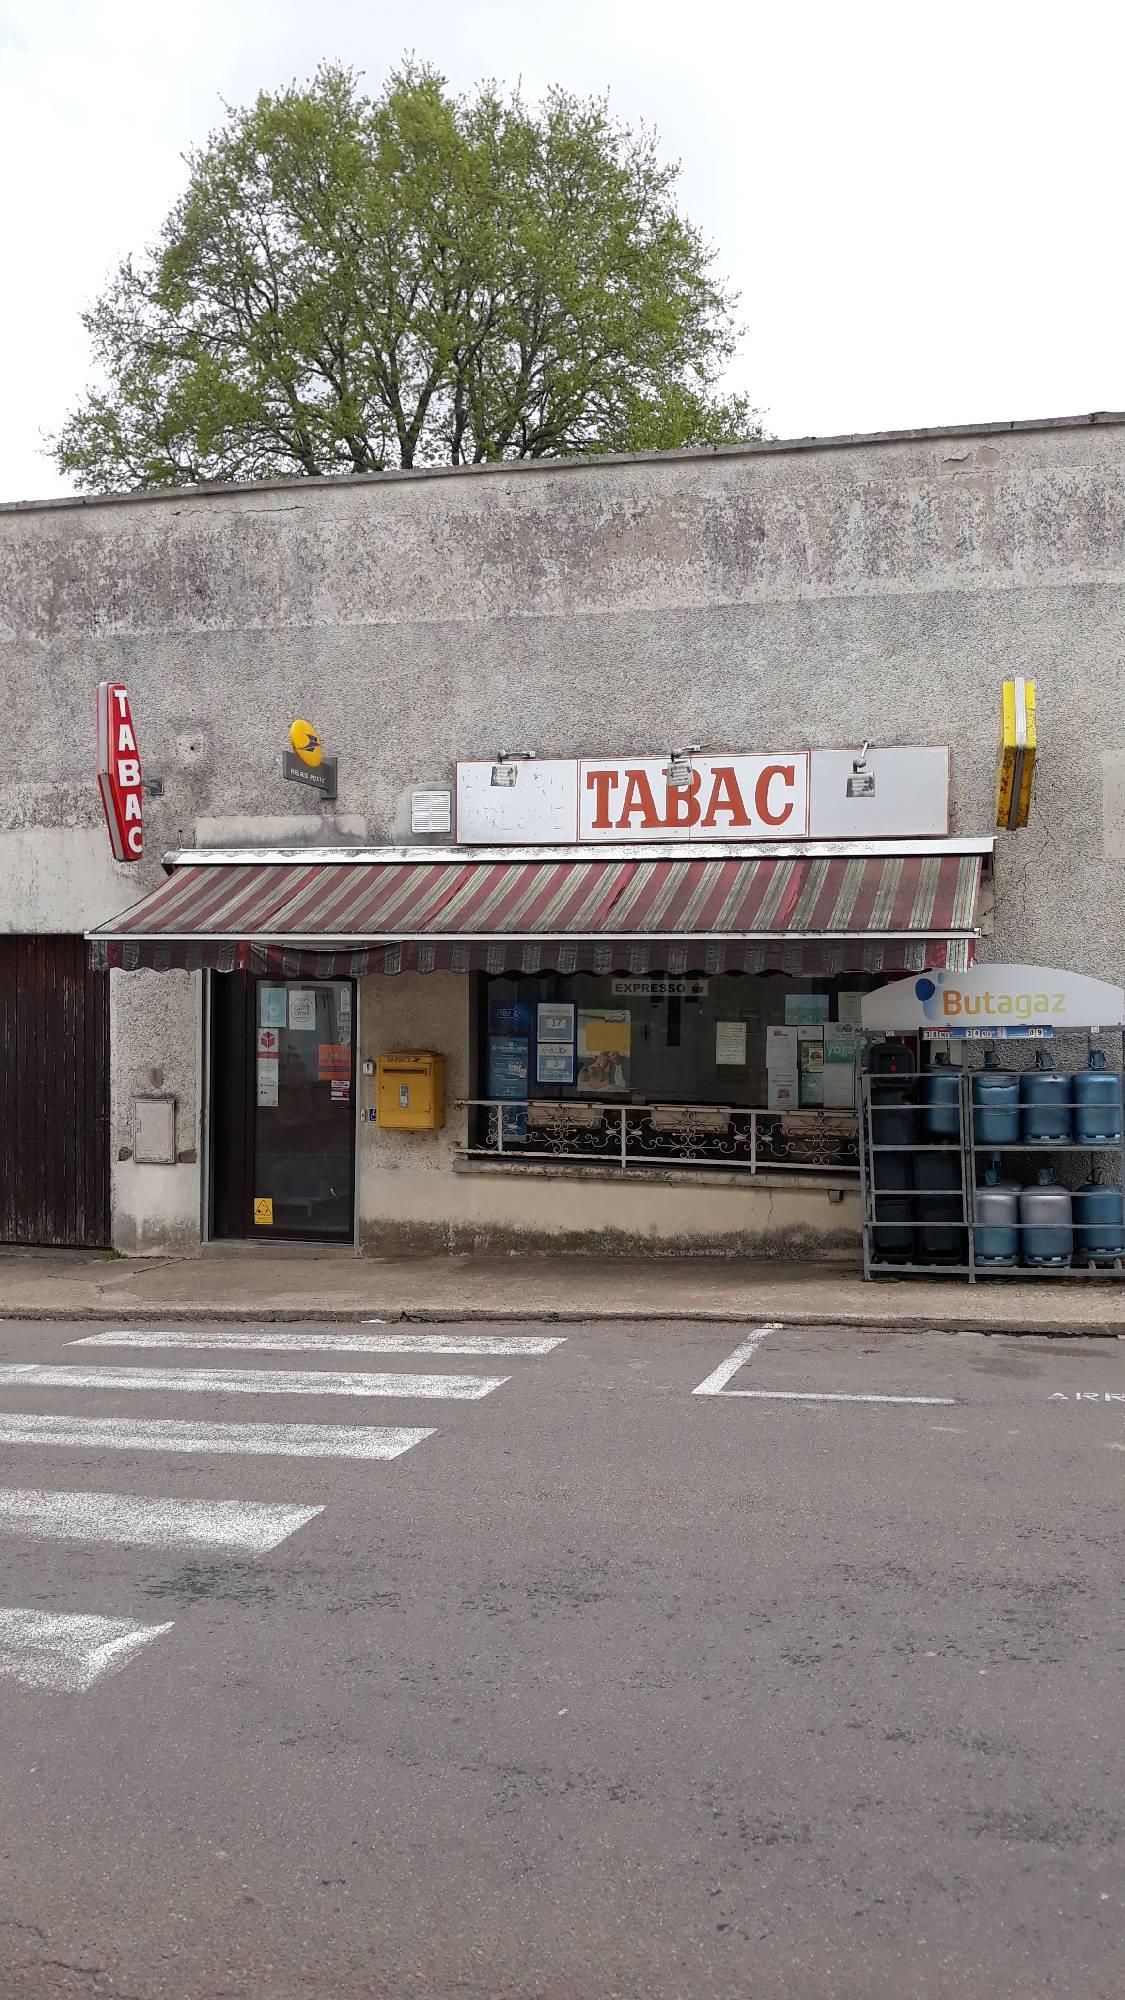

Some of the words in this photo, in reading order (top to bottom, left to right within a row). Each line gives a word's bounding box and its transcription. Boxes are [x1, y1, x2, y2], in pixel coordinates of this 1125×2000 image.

[113, 689, 142, 854] TABAC
[586, 765, 795, 829] TABAC
[615, 983, 686, 993] EXPRESSO
[943, 989, 1066, 1019] Butagaz
[827, 1046, 854, 1057] yoga
